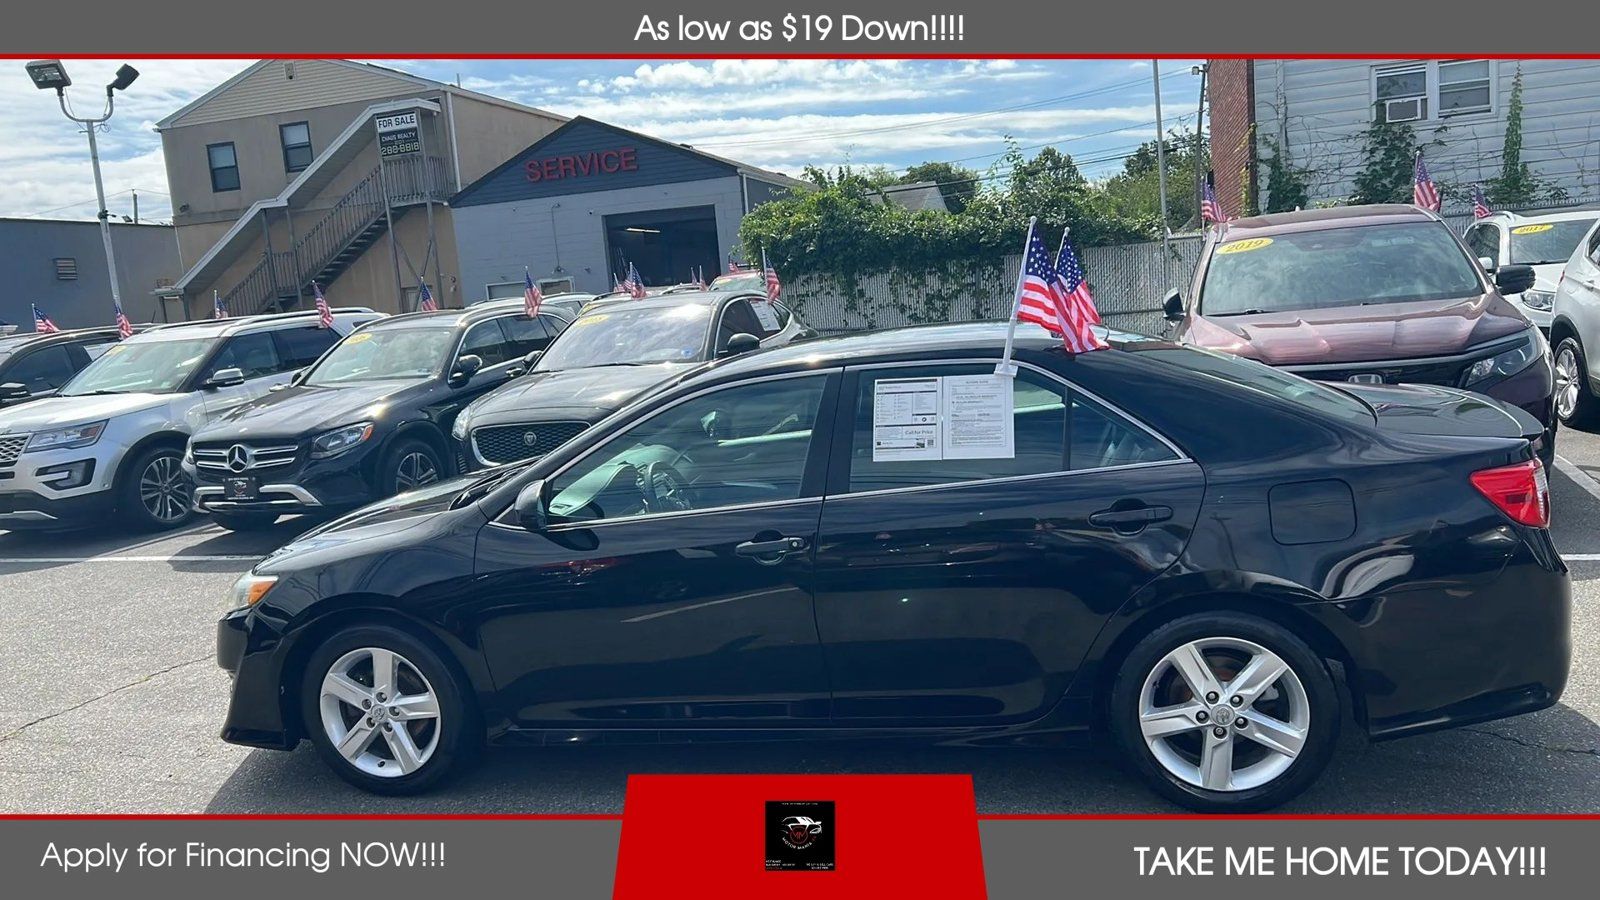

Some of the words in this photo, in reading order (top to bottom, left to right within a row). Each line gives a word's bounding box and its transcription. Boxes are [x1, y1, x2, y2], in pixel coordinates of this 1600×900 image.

[378, 119, 392, 128] FOR
[394, 115, 415, 125] SALE
[524, 147, 638, 182] SERVICE
[1225, 239, 1265, 253] 2019
